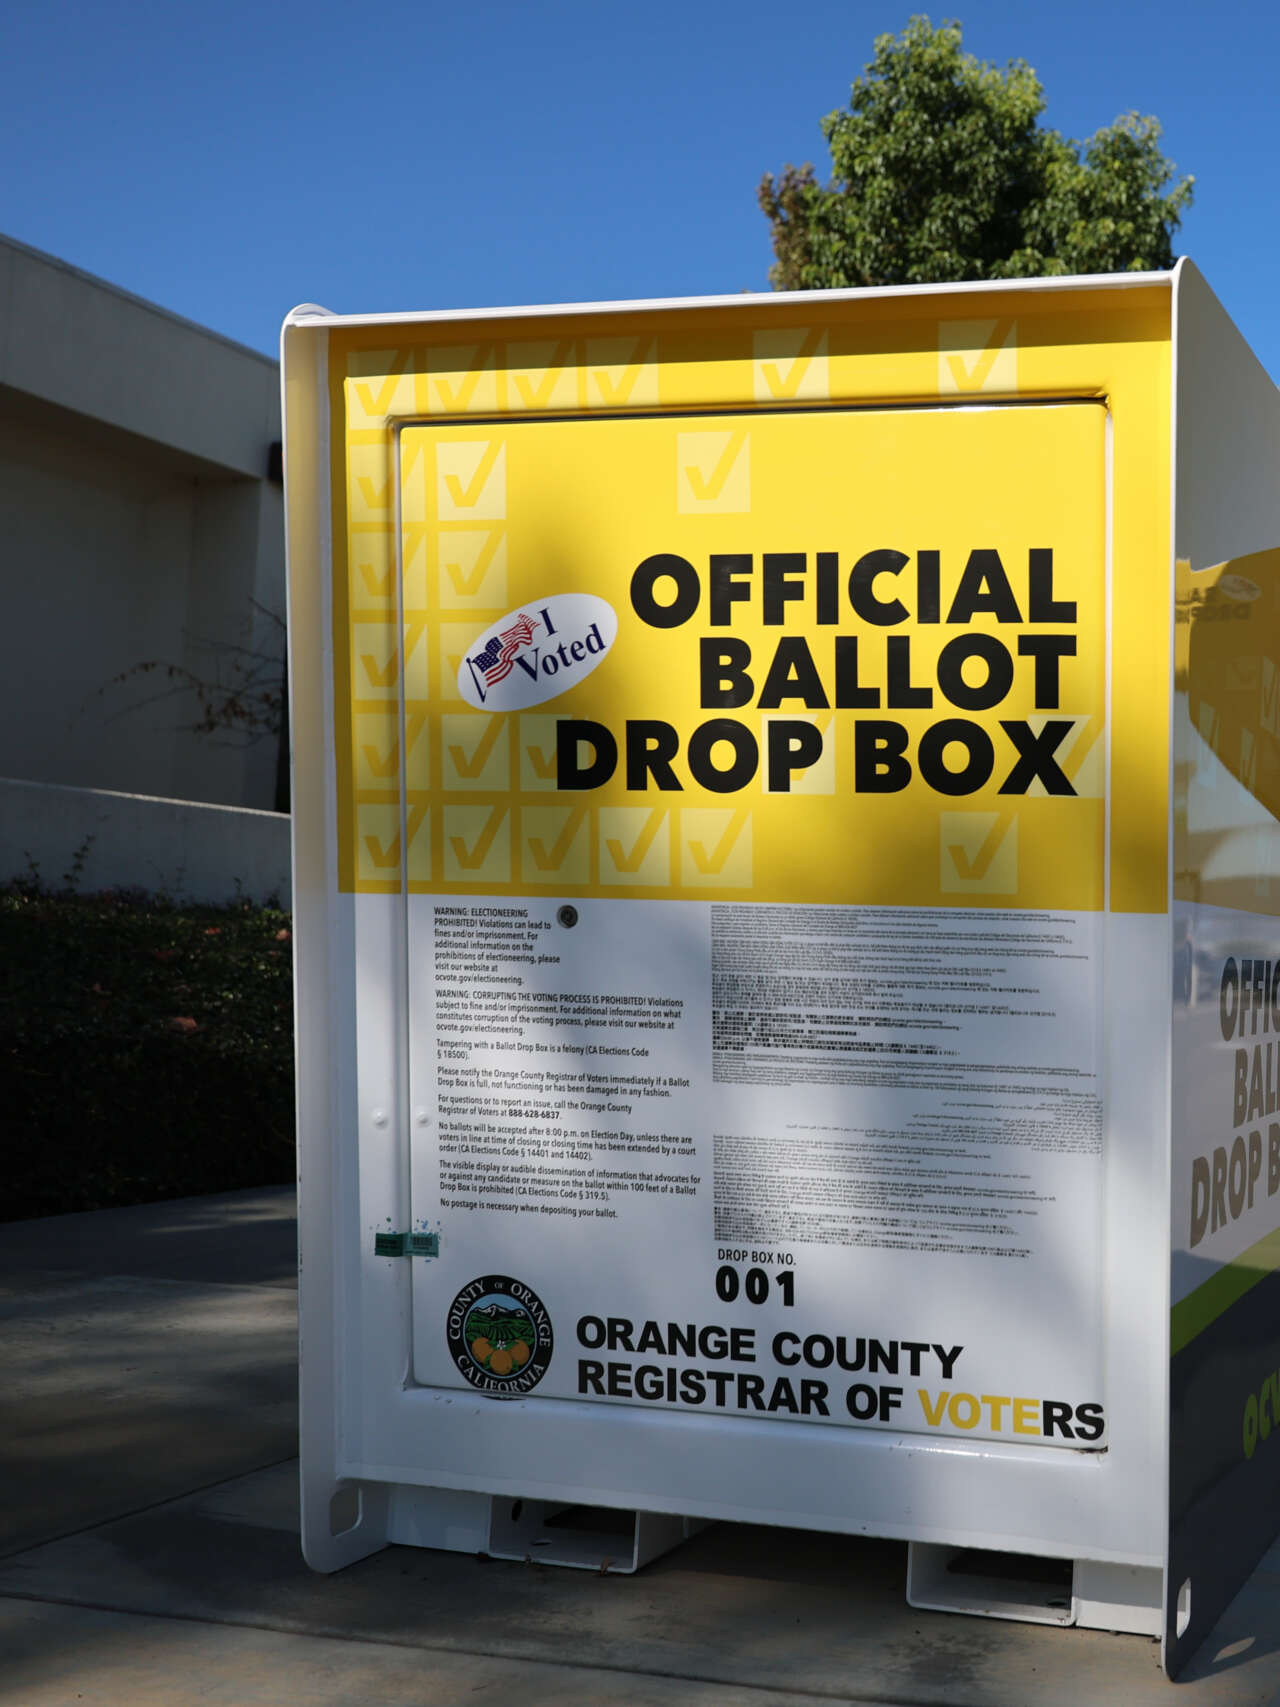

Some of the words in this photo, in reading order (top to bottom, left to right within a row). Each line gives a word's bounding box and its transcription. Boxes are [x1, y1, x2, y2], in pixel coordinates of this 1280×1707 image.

[631, 547, 1077, 628] OFFICIAL
[541, 608, 556, 637] I
[516, 624, 607, 682] Voted
[700, 633, 1077, 711] BALLOT
[557, 719, 823, 793] DROP
[854, 718, 1079, 796] BOX
[470, 908, 528, 917] ELECTIONEERING
[452, 930, 474, 938] and/or
[526, 932, 538, 940] For
[478, 920, 513, 928] Violations
[527, 921, 542, 929] lead
[434, 941, 468, 949] additional
[470, 942, 510, 950] information
[434, 952, 476, 962] prohibitions
[537, 955, 560, 964] please
[437, 1067, 459, 1075] Please
[460, 1068, 480, 1078] notify
[481, 1069, 492, 1077] the
[493, 1070, 519, 1080] Orange
[519, 1071, 544, 1081] County
[545, 1072, 576, 1083] Registrar
[586, 1074, 608, 1083] Voters
[609, 1076, 654, 1087] immediately
[668, 1078, 689, 1086] Ballot
[438, 1106, 468, 1117] Registrar
[478, 1108, 498, 1116] Voters
[438, 1144, 456, 1152] order
[458, 1145, 470, 1155] (CA
[470, 1146, 500, 1154] Elections
[502, 1148, 519, 1156] Code
[527, 1149, 548, 1157] 14401
[550, 1150, 564, 1158] and
[439, 1160, 451, 1168] The
[452, 1161, 474, 1170] visible
[475, 1163, 500, 1173] display
[510, 1165, 536, 1173] audible
[537, 1166, 586, 1176] dissemination
[595, 1170, 637, 1179] information
[638, 1172, 653, 1180] that
[654, 1173, 689, 1182] advocates
[439, 1183, 456, 1193] Drop
[457, 1184, 470, 1192] Box
[478, 1185, 514, 1196] prohibited
[515, 1187, 527, 1197] (CA
[528, 1188, 558, 1197] Elections
[559, 1190, 577, 1198] Code
[448, 1172, 472, 1183] against
[473, 1175, 486, 1184] any
[487, 1174, 520, 1183] candidate
[571, 1180, 583, 1188] the
[584, 1181, 604, 1189] ballot
[606, 1182, 628, 1190] within
[630, 1183, 644, 1191] 100
[645, 1184, 659, 1192] feet
[675, 1186, 696, 1194] Ballot
[1190, 1129, 1263, 1250] DROP
[450, 1199, 477, 1210] postage
[486, 1204, 518, 1213] necessary
[519, 1204, 539, 1212] when
[540, 1205, 577, 1217] depositing
[578, 1210, 594, 1218] your
[718, 1249, 747, 1263] DROP
[751, 1251, 774, 1265] BOX
[776, 1253, 796, 1266] NO.
[715, 1267, 796, 1306] 001
[450, 1280, 486, 1340] COUNTY
[510, 1282, 551, 1348] ORANGE
[576, 1315, 756, 1362] ORANGE
[772, 1331, 964, 1380] COUNTY
[457, 1354, 545, 1393] CALIFORNIA
[578, 1358, 830, 1417] REGISTRAR
[846, 1384, 903, 1422] OF
[918, 1389, 1106, 1442] VOTERS
